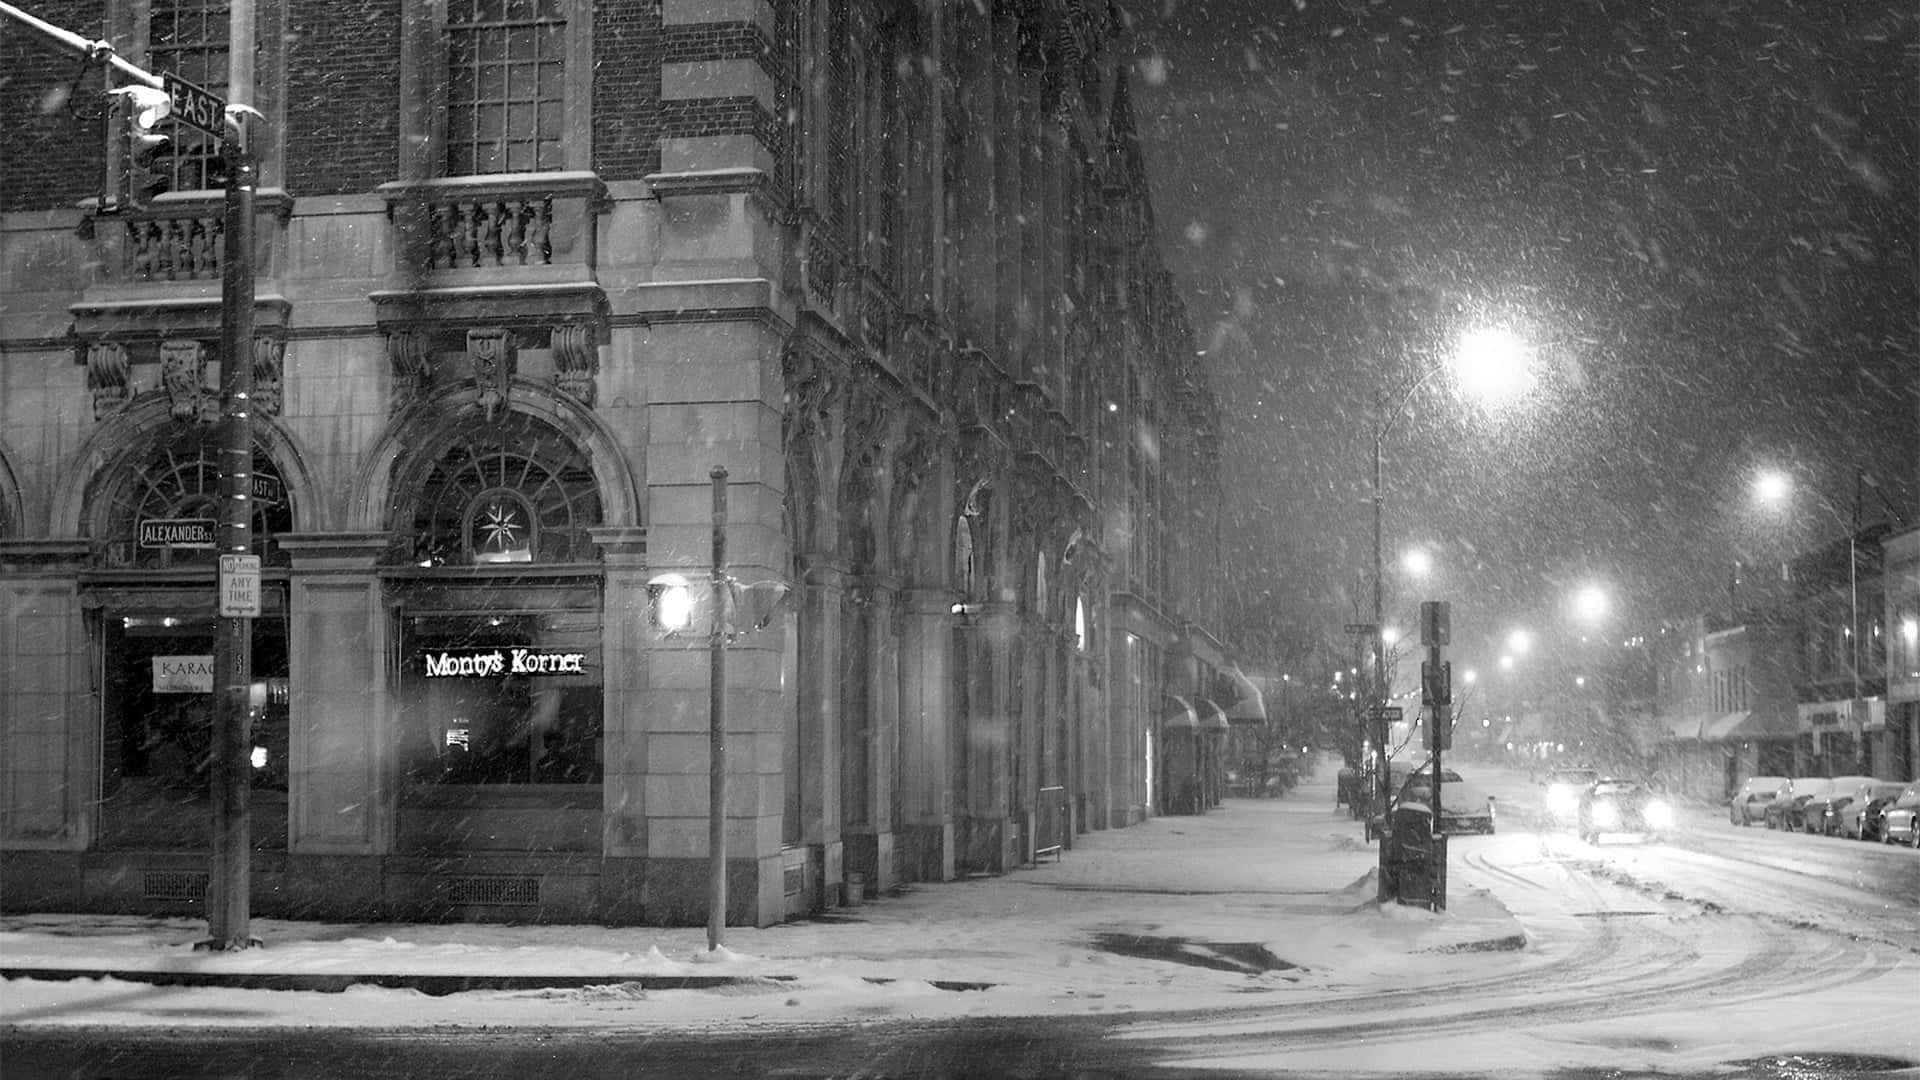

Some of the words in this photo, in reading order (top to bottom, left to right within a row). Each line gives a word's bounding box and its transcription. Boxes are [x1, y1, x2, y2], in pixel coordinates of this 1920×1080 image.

[171, 82, 217, 130] EAST
[253, 479, 268, 496] AST
[144, 525, 204, 541] ALEXANDER
[223, 559, 234, 571] NO
[231, 577, 252, 587] ANY
[229, 590, 252, 602] TIME
[425, 650, 503, 677] Monty's
[511, 649, 584, 673] Korner
